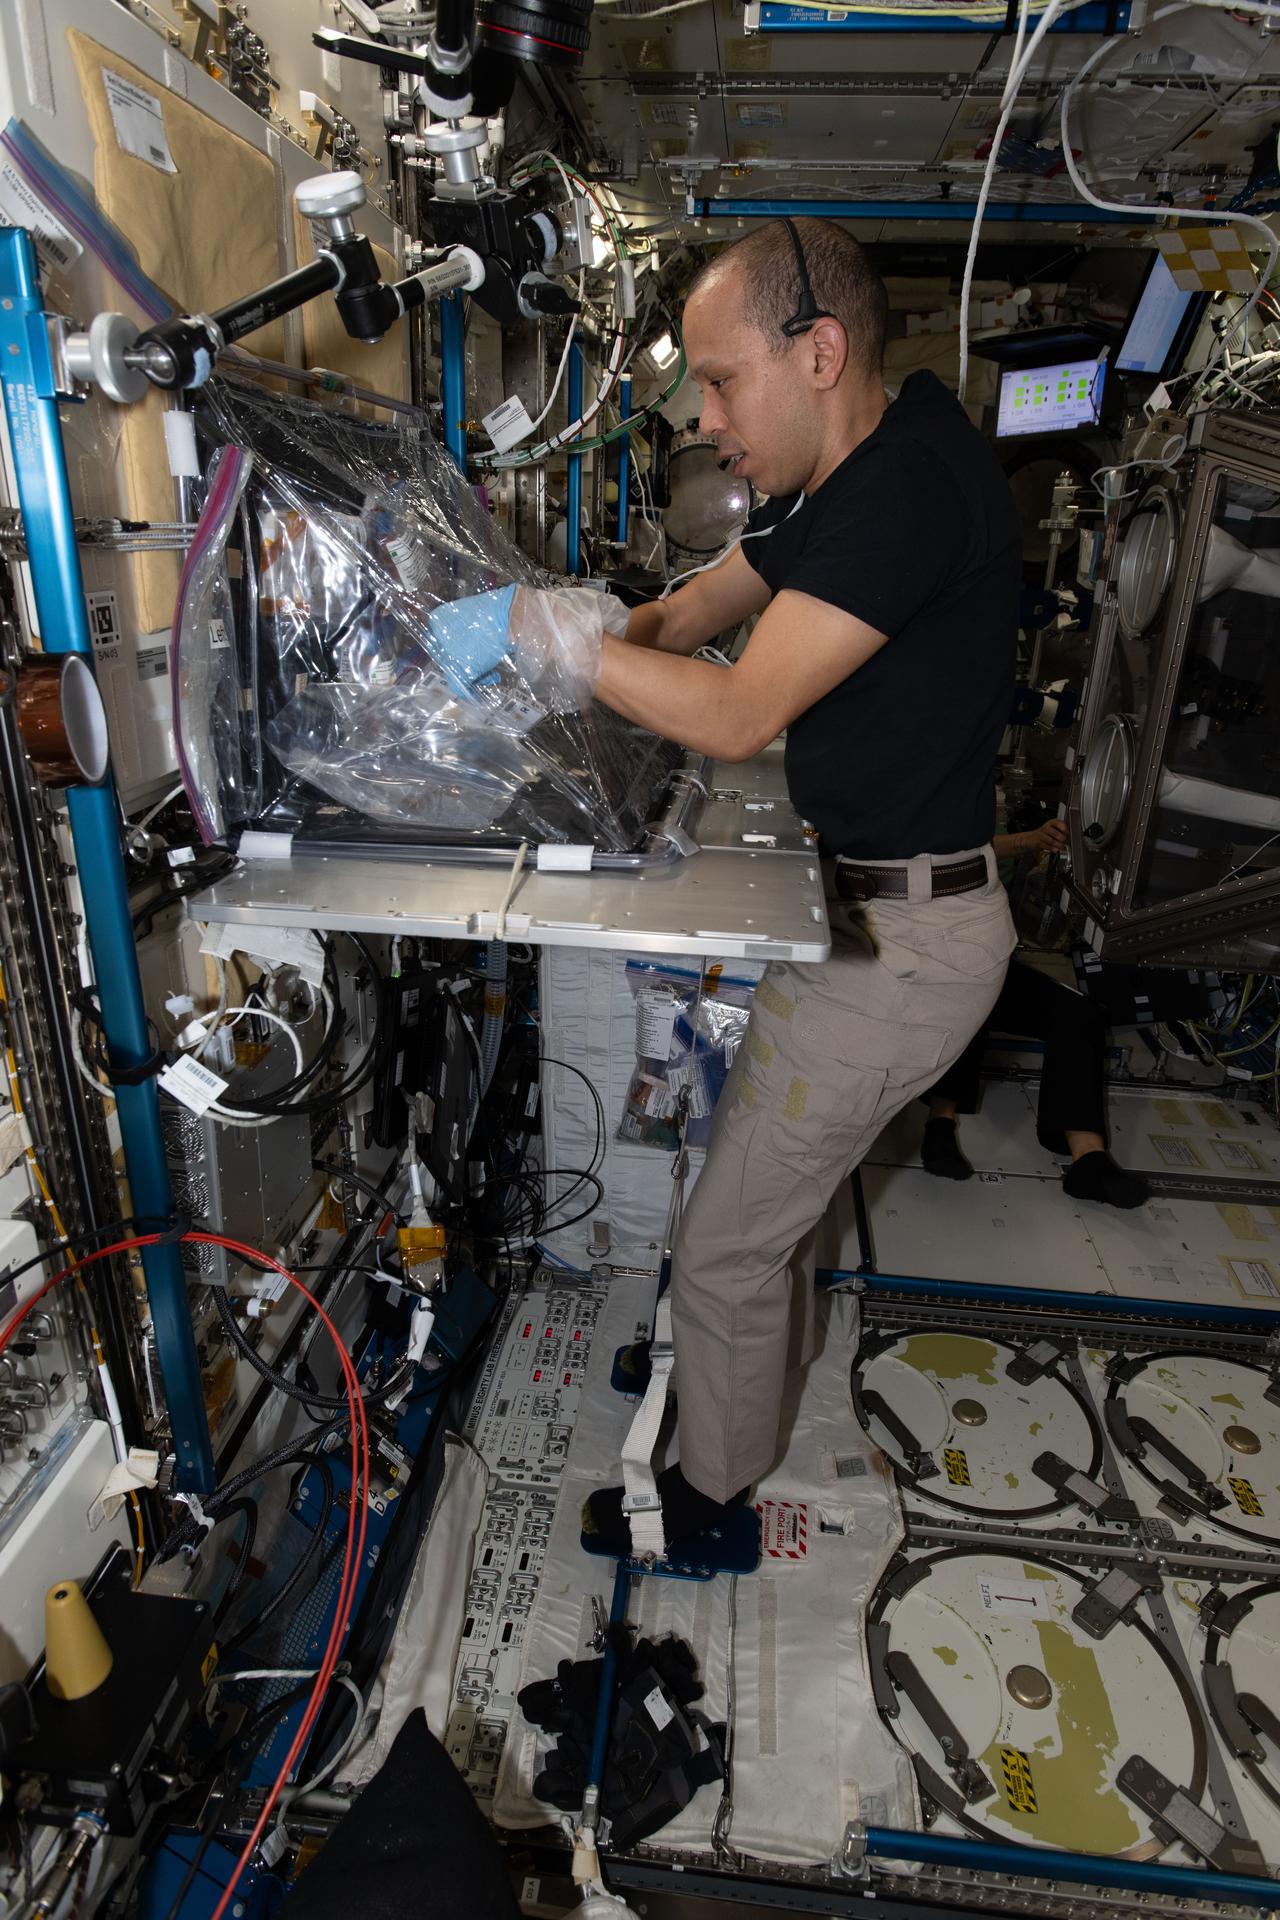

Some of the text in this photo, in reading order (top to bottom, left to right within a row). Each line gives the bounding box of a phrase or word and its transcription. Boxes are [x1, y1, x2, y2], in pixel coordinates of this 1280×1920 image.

[467, 1403, 481, 1429] MINUS
[478, 1378, 490, 1404] EIGHTY
[484, 1362, 495, 1378] LAB
[490, 1331, 506, 1363] FREEZER
[488, 1389, 500, 1418] ELECTRONIC
[372, 1500, 386, 1514] D
[776, 1507, 786, 1548] FIRE PORT
[981, 1584, 992, 1608] MELFI
[995, 1595, 1037, 1607] 1
